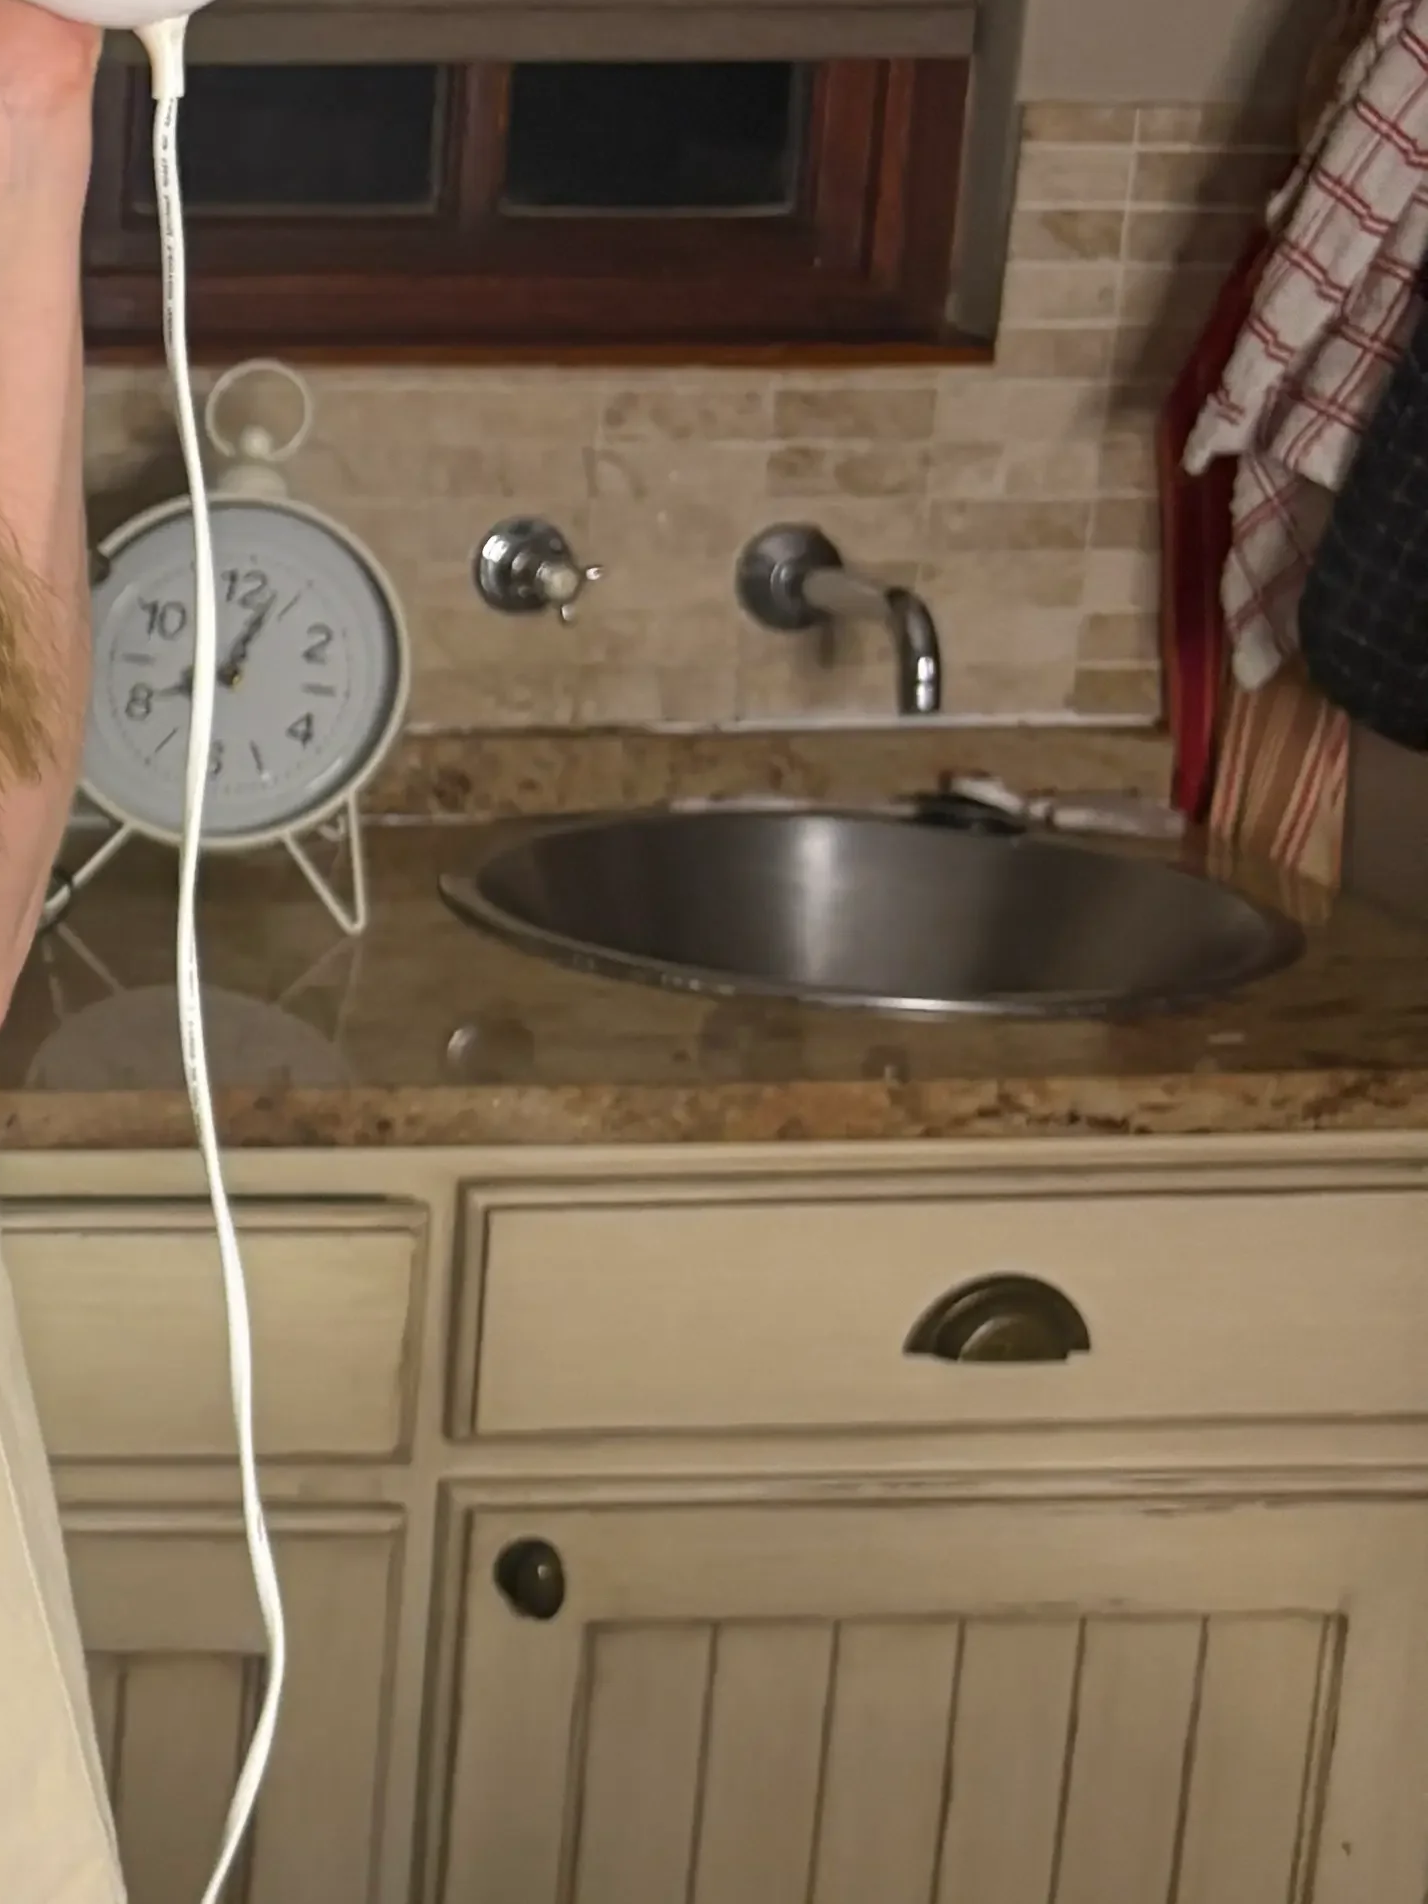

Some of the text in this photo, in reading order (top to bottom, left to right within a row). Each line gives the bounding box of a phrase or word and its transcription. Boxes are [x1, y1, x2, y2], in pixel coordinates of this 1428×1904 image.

[220, 569, 268, 609] 12
[140, 600, 187, 641] 10
[302, 623, 334, 665] 2
[124, 682, 153, 721] 8
[286, 712, 315, 750] 4
